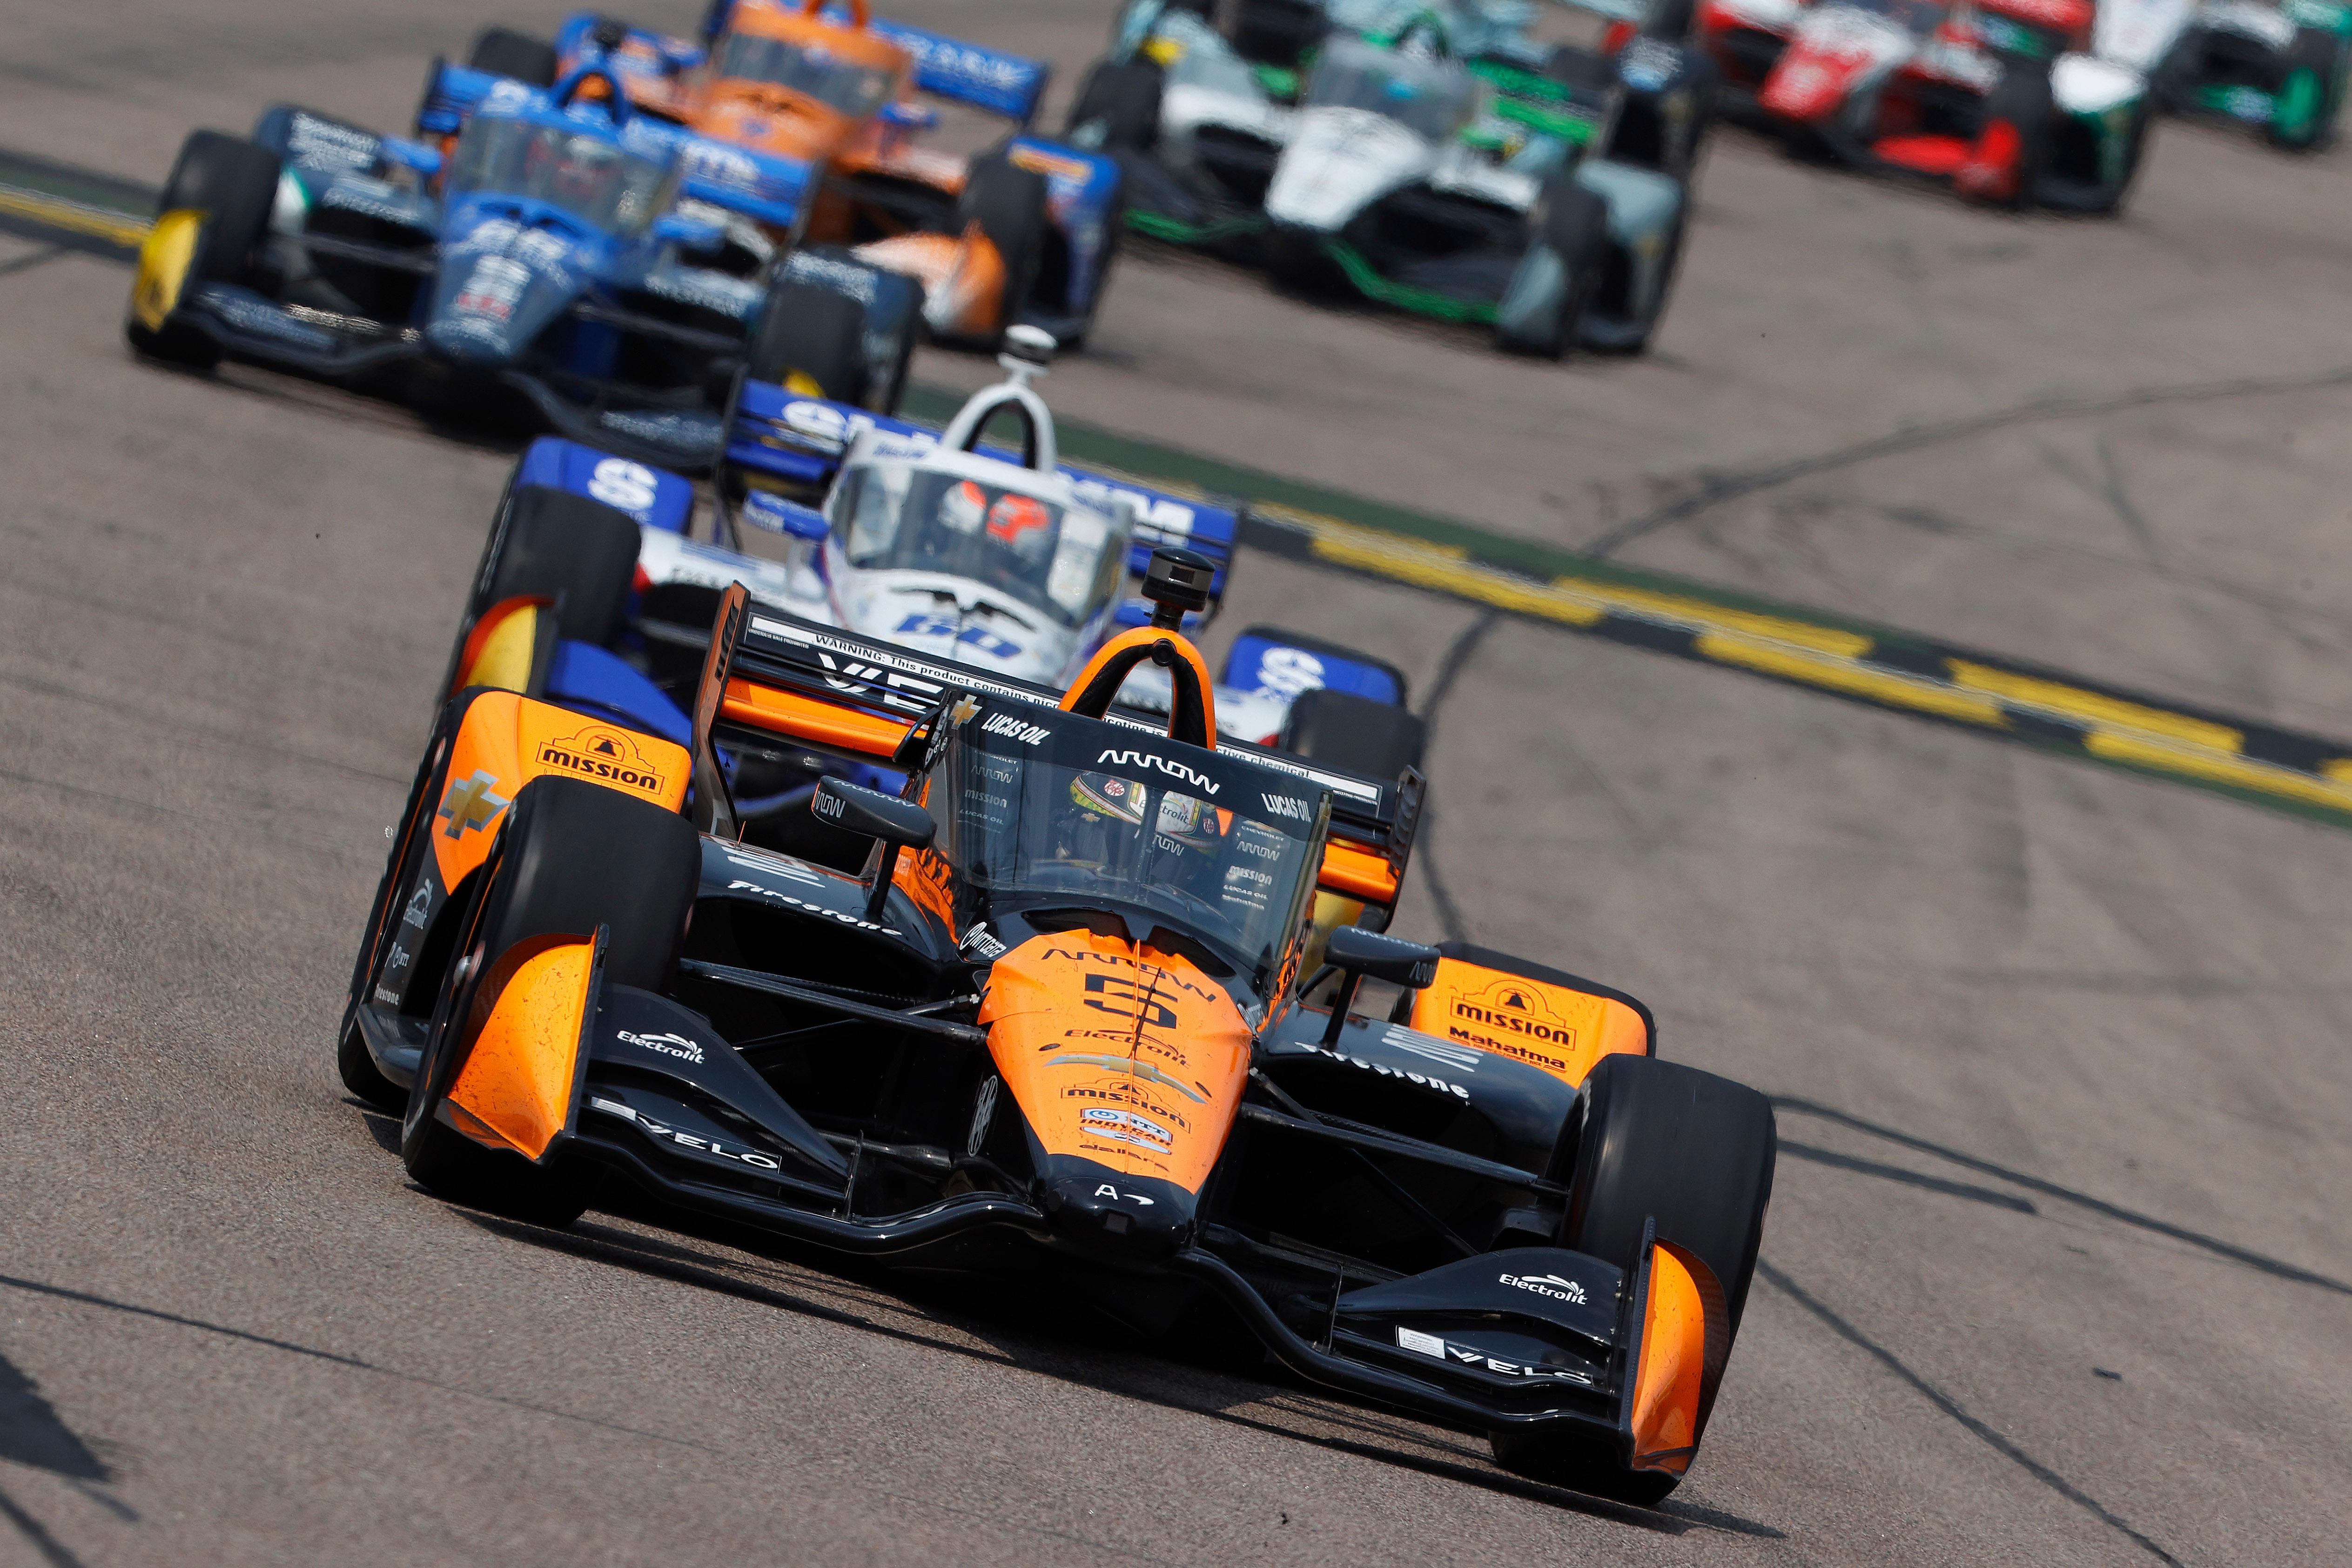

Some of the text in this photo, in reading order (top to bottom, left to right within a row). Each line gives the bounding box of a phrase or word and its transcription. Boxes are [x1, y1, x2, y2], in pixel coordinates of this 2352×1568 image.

[815, 634, 885, 661] WARNING:
[891, 656, 916, 671] This
[921, 667, 970, 686] product
[974, 681, 1029, 702] contains
[981, 712, 1051, 746] LUCAS OIL
[1097, 749, 1220, 795] ARROW
[1261, 793, 1298, 819] LUCAS
[1297, 797, 1312, 822] OIL
[1083, 973, 1178, 1029] 5
[617, 1030, 705, 1064] Electrolit
[1450, 1026, 1566, 1070] Mahatma
[1499, 1273, 1589, 1306] Electrolit
[1446, 1346, 1592, 1385] VELO
